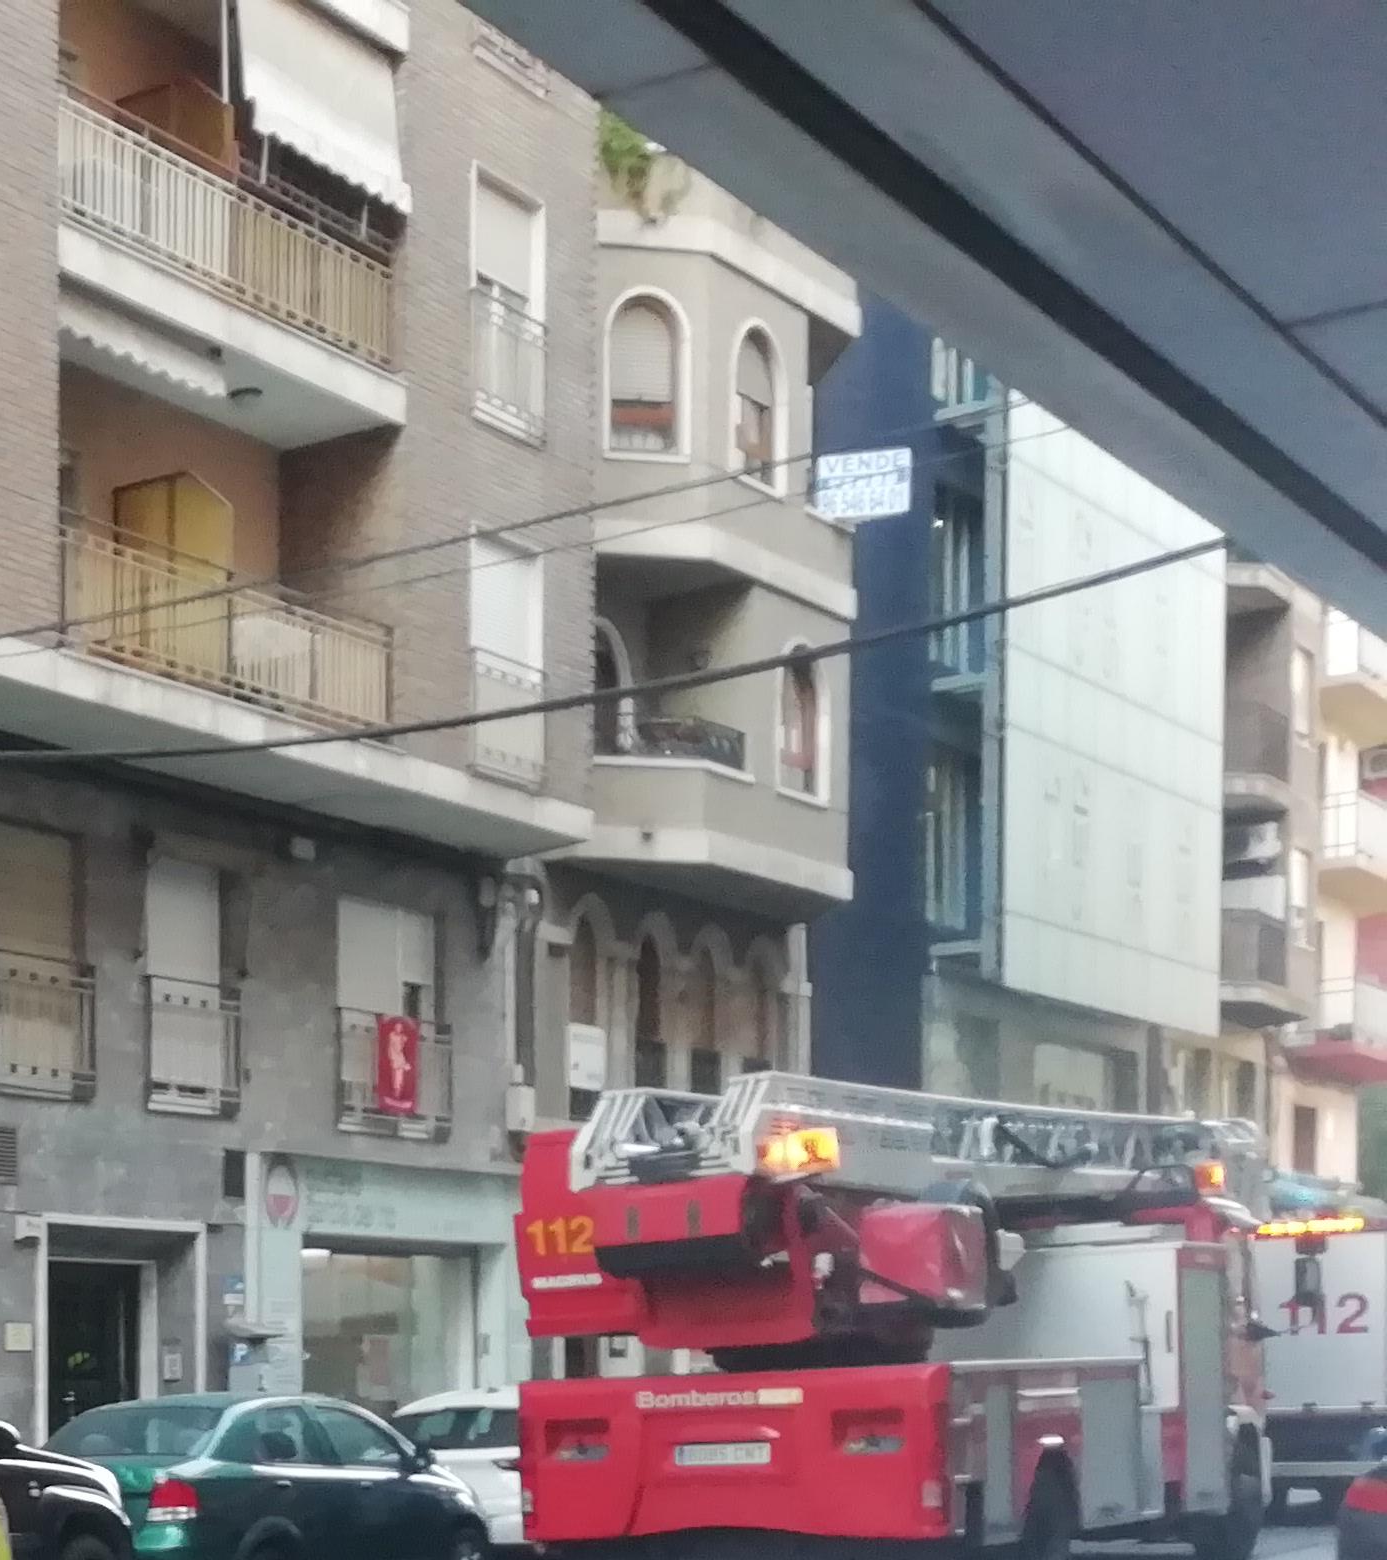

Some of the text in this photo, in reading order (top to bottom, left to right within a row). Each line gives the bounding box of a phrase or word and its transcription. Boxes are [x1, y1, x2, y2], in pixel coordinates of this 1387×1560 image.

[826, 450, 907, 474] VENDE
[527, 1214, 595, 1256] 112
[635, 1390, 759, 1409] Bomberos
